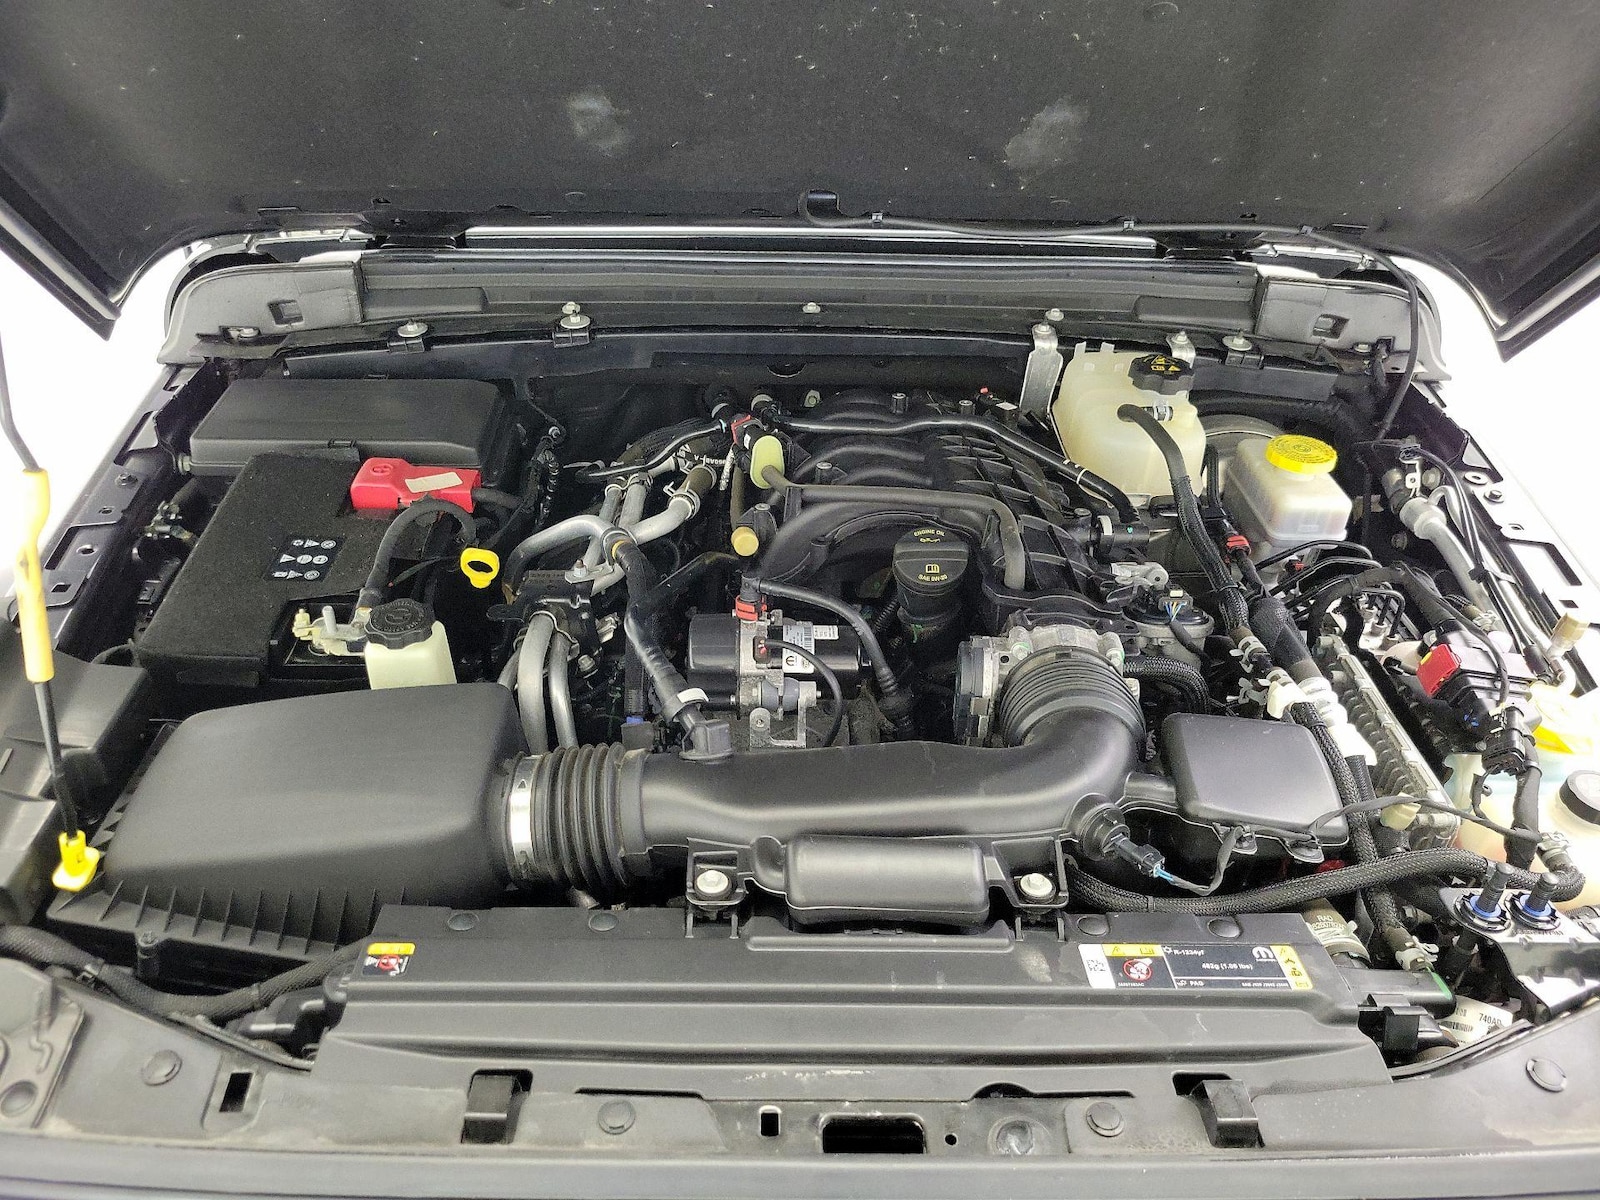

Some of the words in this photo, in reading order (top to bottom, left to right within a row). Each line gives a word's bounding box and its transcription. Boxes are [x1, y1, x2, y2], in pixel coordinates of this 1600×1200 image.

[913, 529, 935, 537] ENGINE
[936, 529, 945, 537] OIL
[918, 573, 931, 581] SAE
